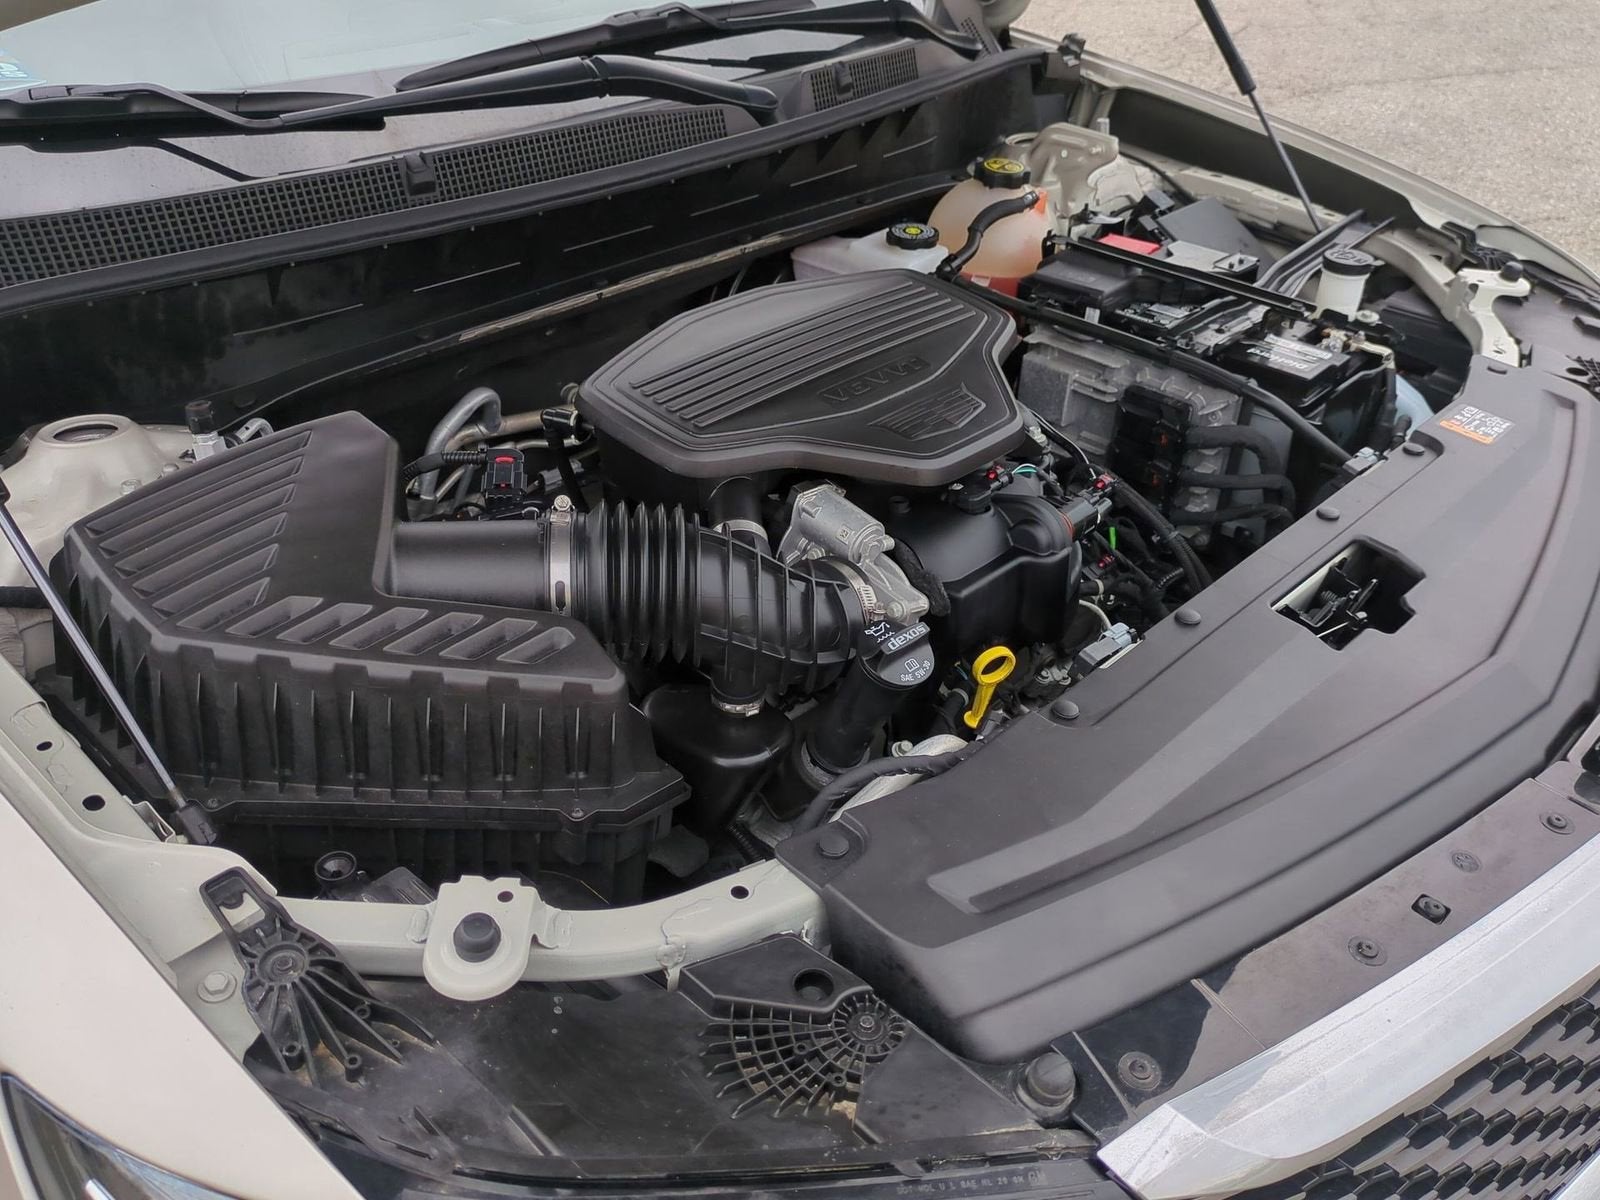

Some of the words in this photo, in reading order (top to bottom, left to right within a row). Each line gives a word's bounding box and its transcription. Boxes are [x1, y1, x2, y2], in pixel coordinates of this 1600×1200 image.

[887, 624, 926, 650] dexos
[900, 673, 914, 682] SAE
[915, 660, 931, 679] 5W-30
